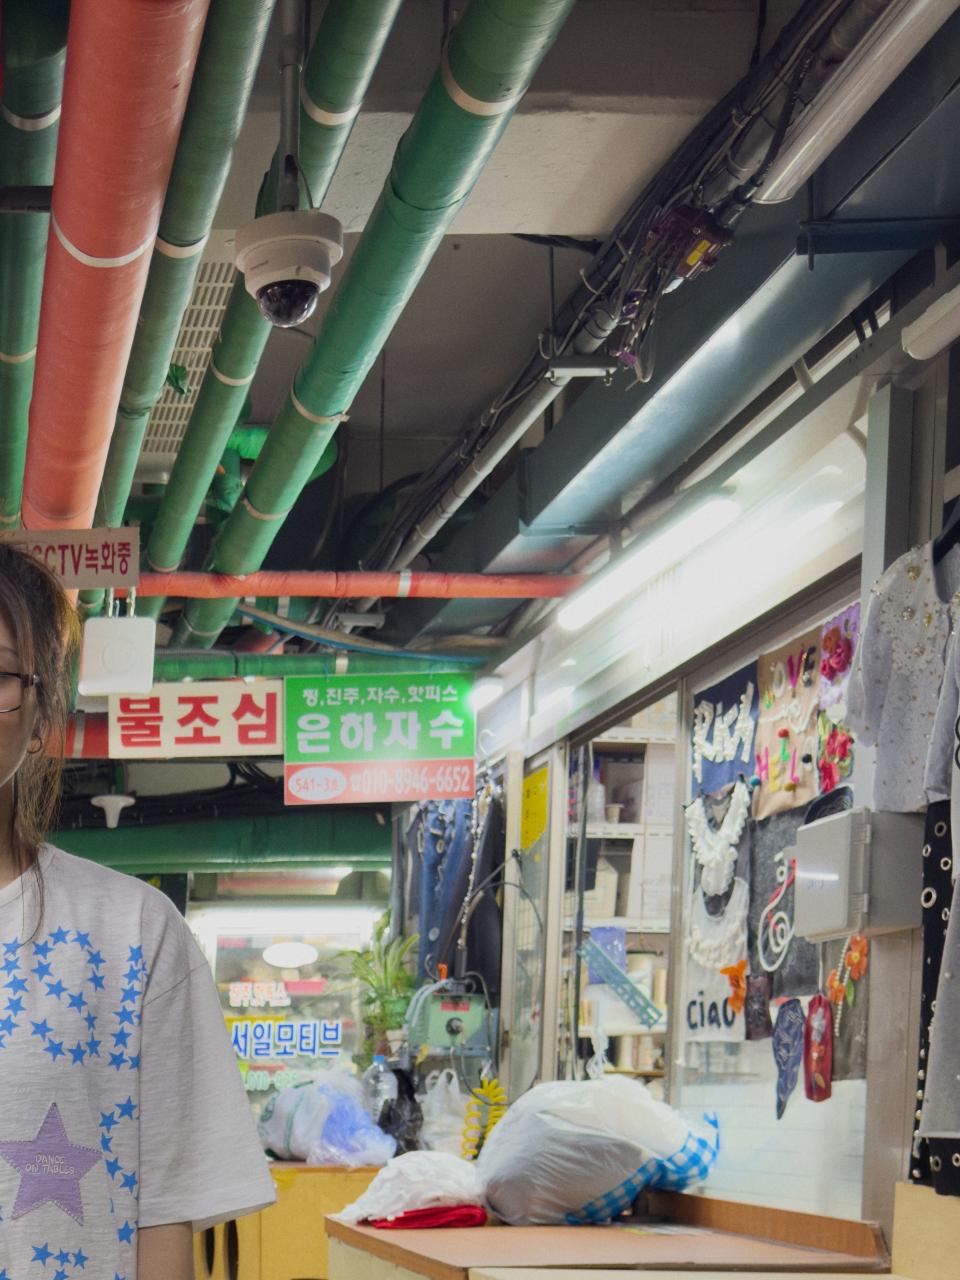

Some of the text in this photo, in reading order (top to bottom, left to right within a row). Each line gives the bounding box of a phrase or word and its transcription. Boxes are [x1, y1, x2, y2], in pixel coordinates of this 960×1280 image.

[116, 691, 278, 748] 불조심
[296, 709, 464, 753] 은하자수
[232, 1022, 340, 1057] 서일모티브
[25, 1163, 74, 1175] ON TABLES
[35, 1153, 65, 1164] DANCE
